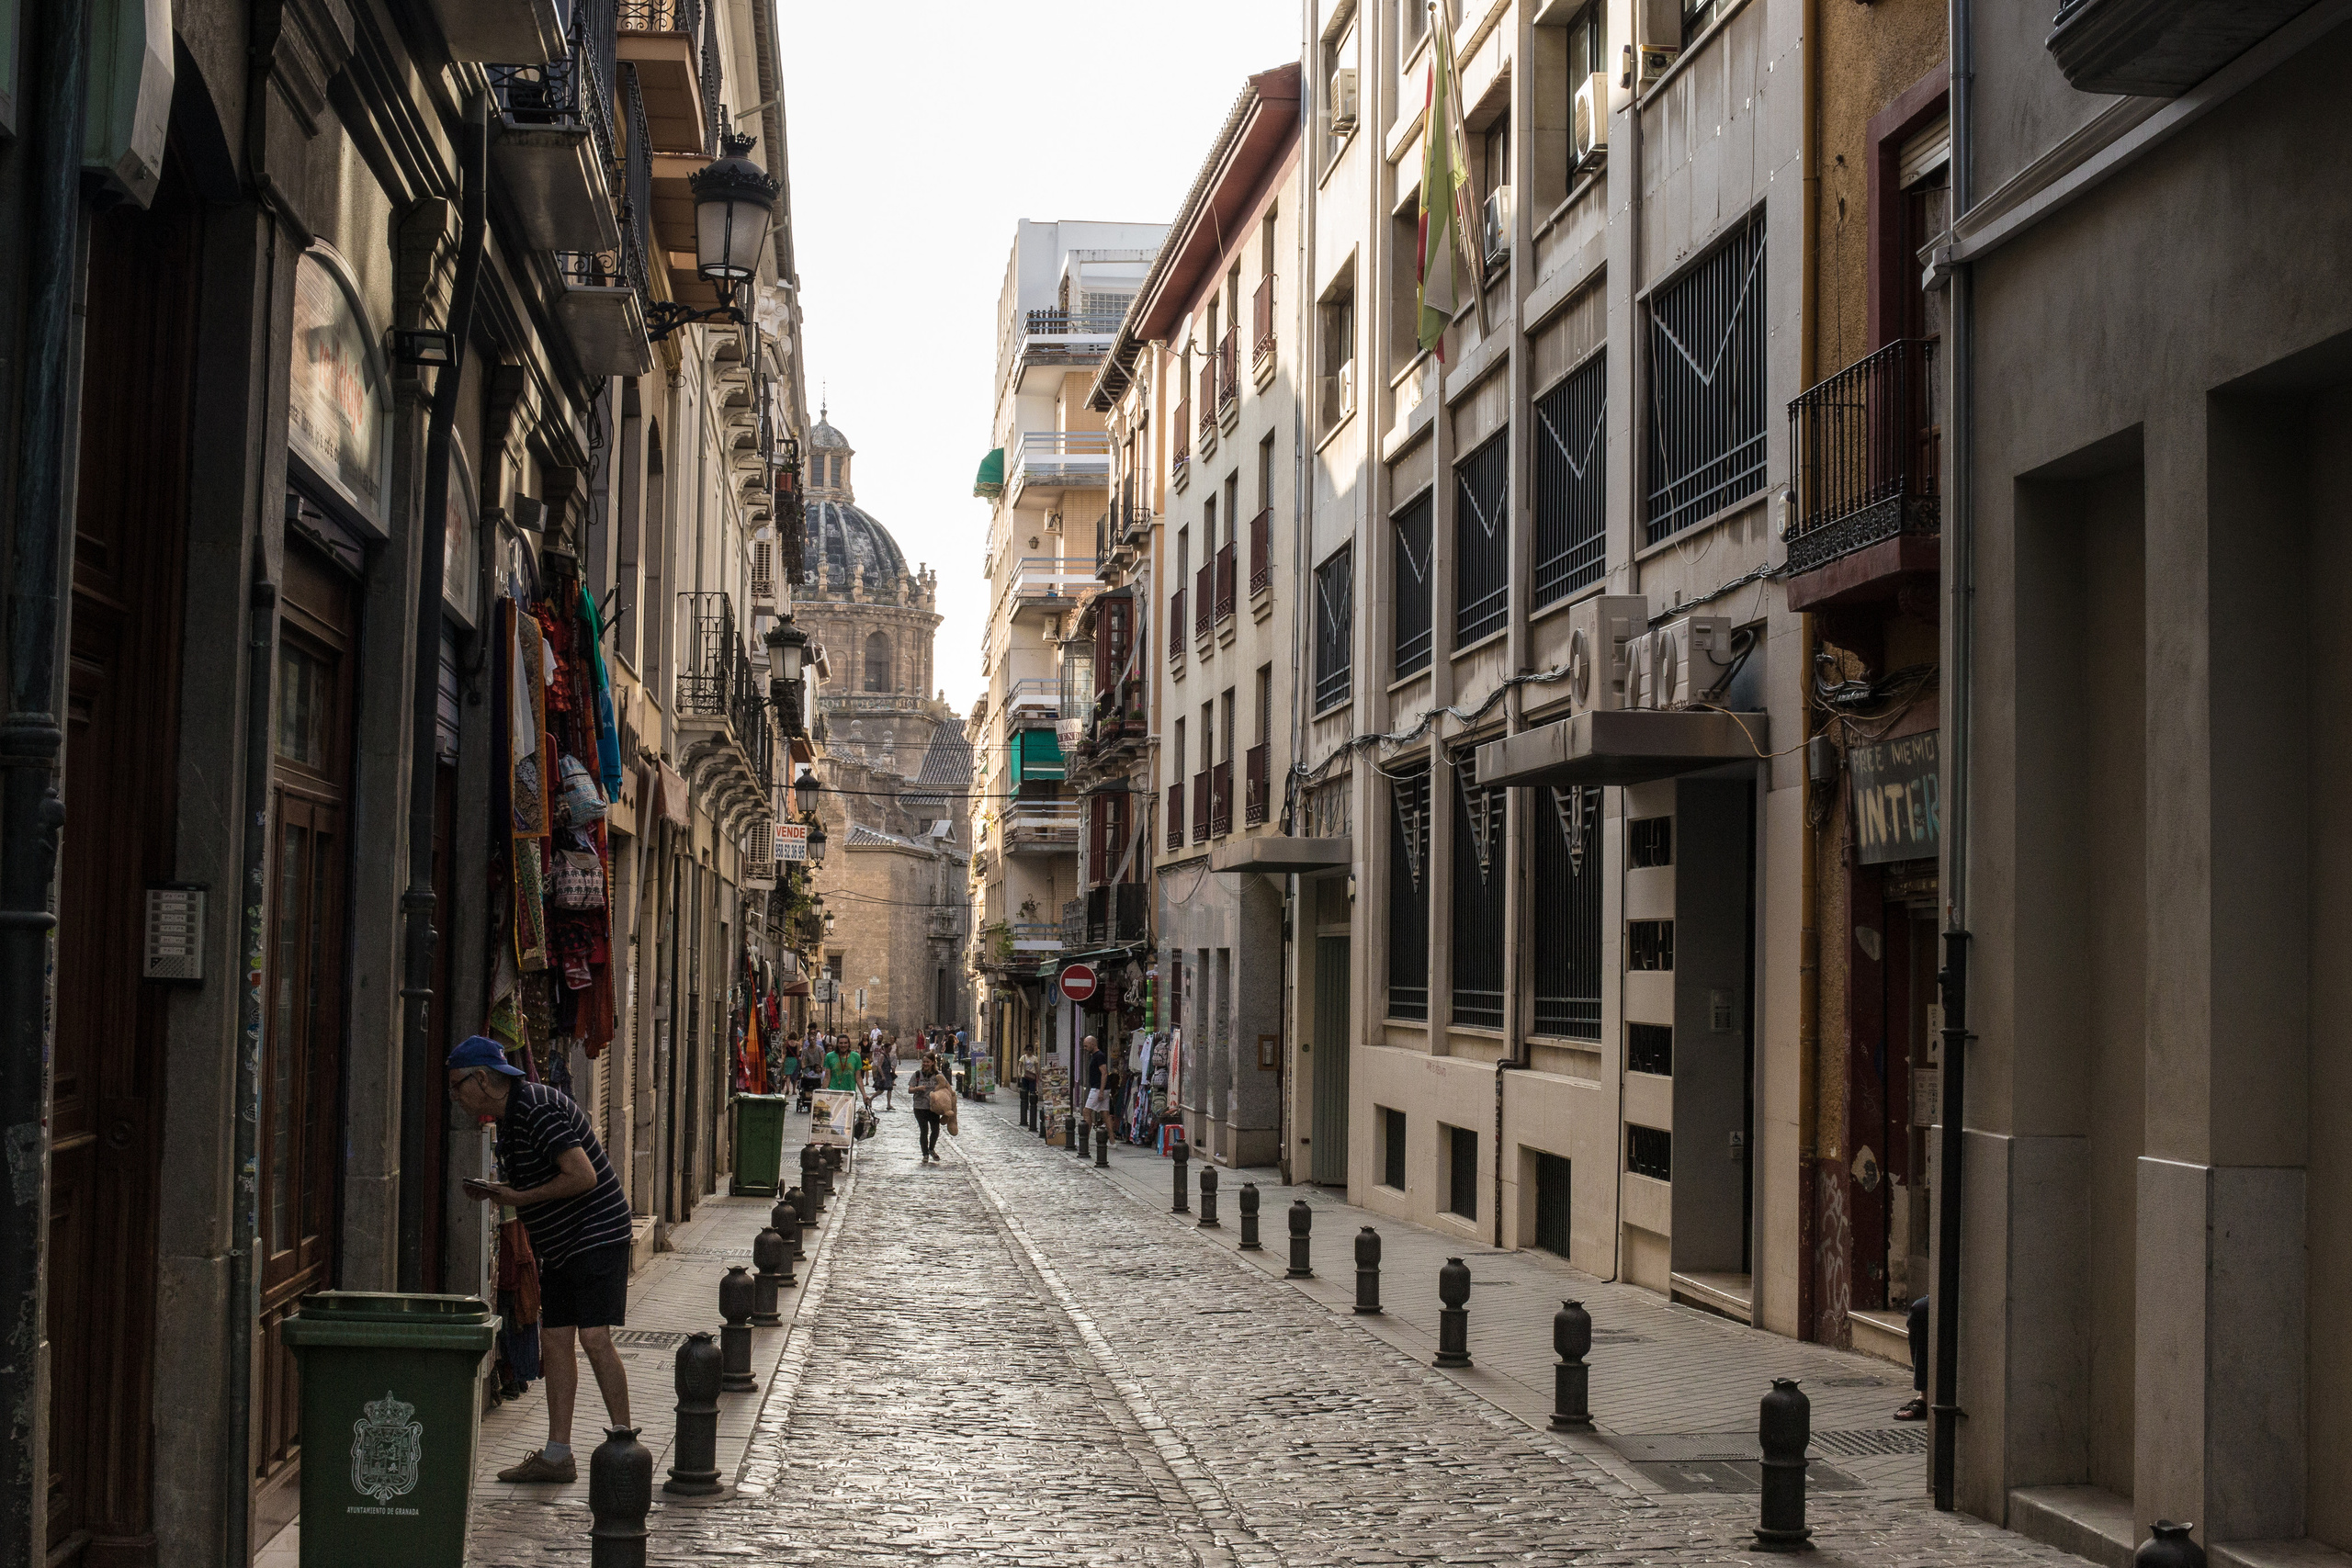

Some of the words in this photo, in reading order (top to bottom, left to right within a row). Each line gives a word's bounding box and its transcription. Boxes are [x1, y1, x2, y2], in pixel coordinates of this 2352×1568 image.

[1891, 733, 1939, 768] MEMO
[776, 826, 805, 839] VENDE
[785, 844, 790, 858] 52
[798, 845, 805, 860] 95
[346, 1506, 386, 1515] AYUNTAMIENTO
[394, 1507, 420, 1516] GRANADA
